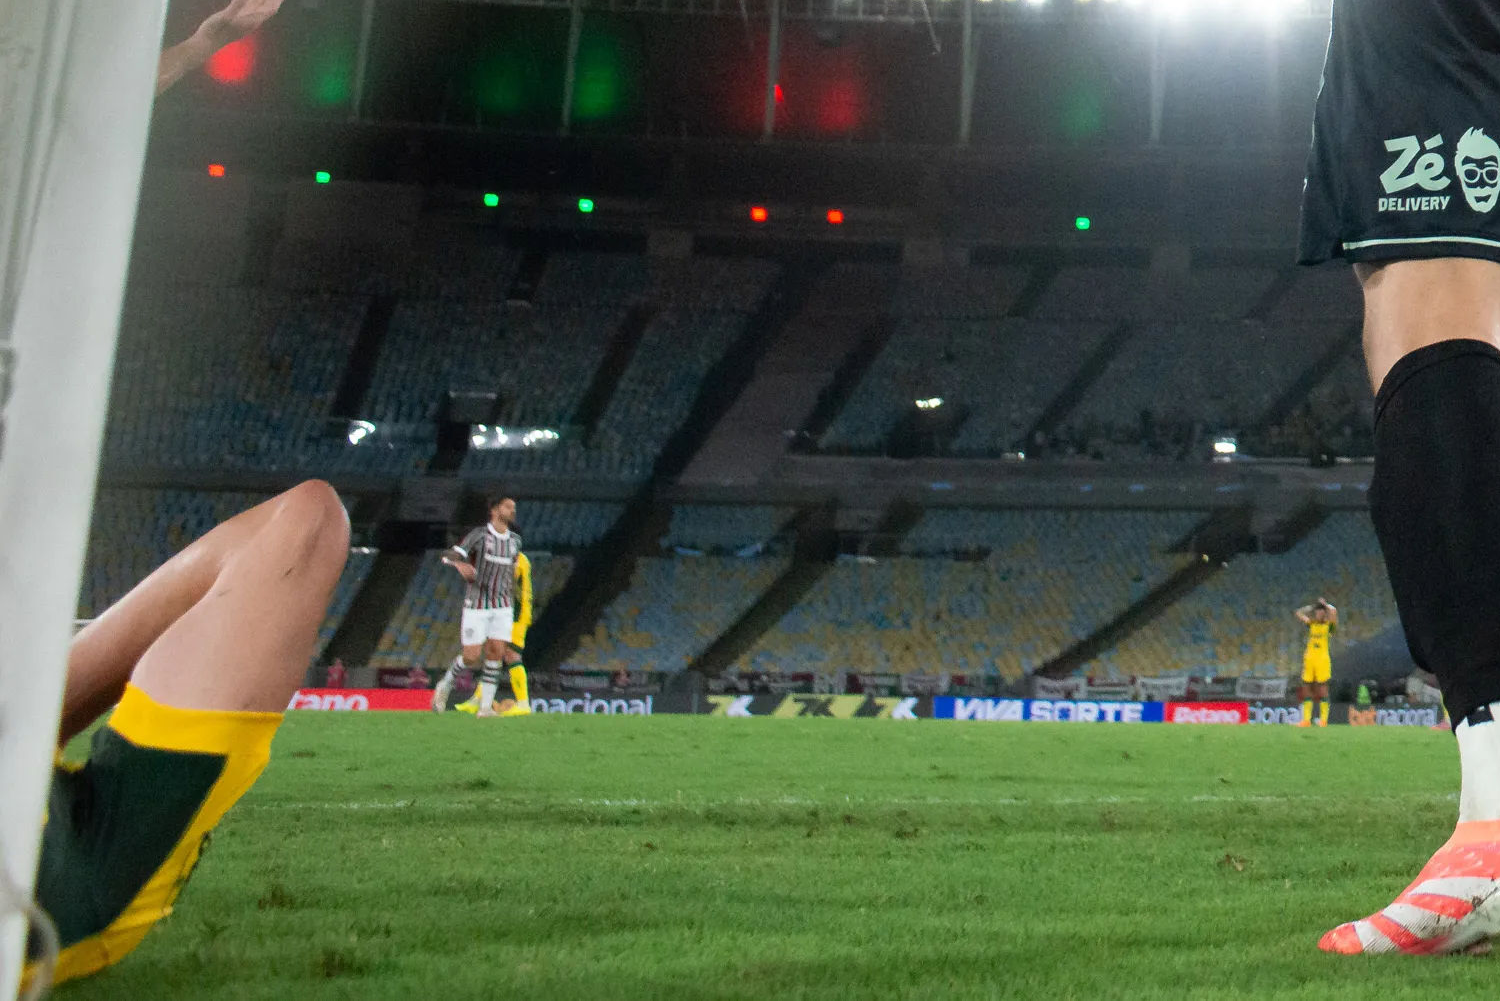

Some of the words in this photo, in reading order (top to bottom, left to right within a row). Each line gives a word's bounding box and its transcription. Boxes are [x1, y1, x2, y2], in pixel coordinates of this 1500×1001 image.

[1380, 133, 1451, 194] Zé
[1378, 195, 1450, 212] DELIVERY
[1029, 700, 1144, 723] SORTE
